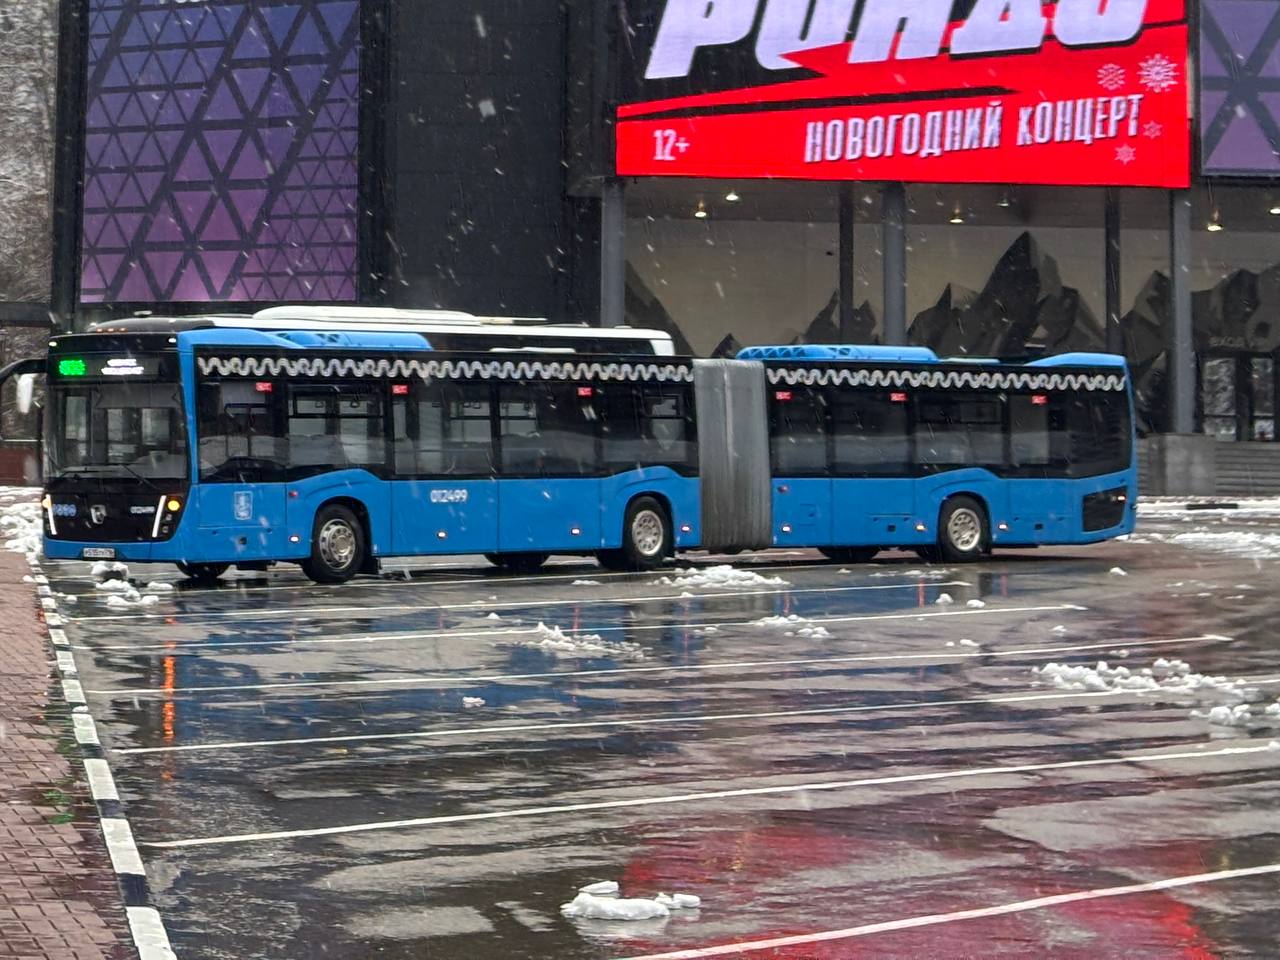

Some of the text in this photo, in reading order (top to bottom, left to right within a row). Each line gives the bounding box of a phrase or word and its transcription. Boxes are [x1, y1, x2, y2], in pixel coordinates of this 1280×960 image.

[652, 129, 691, 161] 12+
[804, 94, 1144, 163] НОВОГОДНИЙ КОНЦЕРТ
